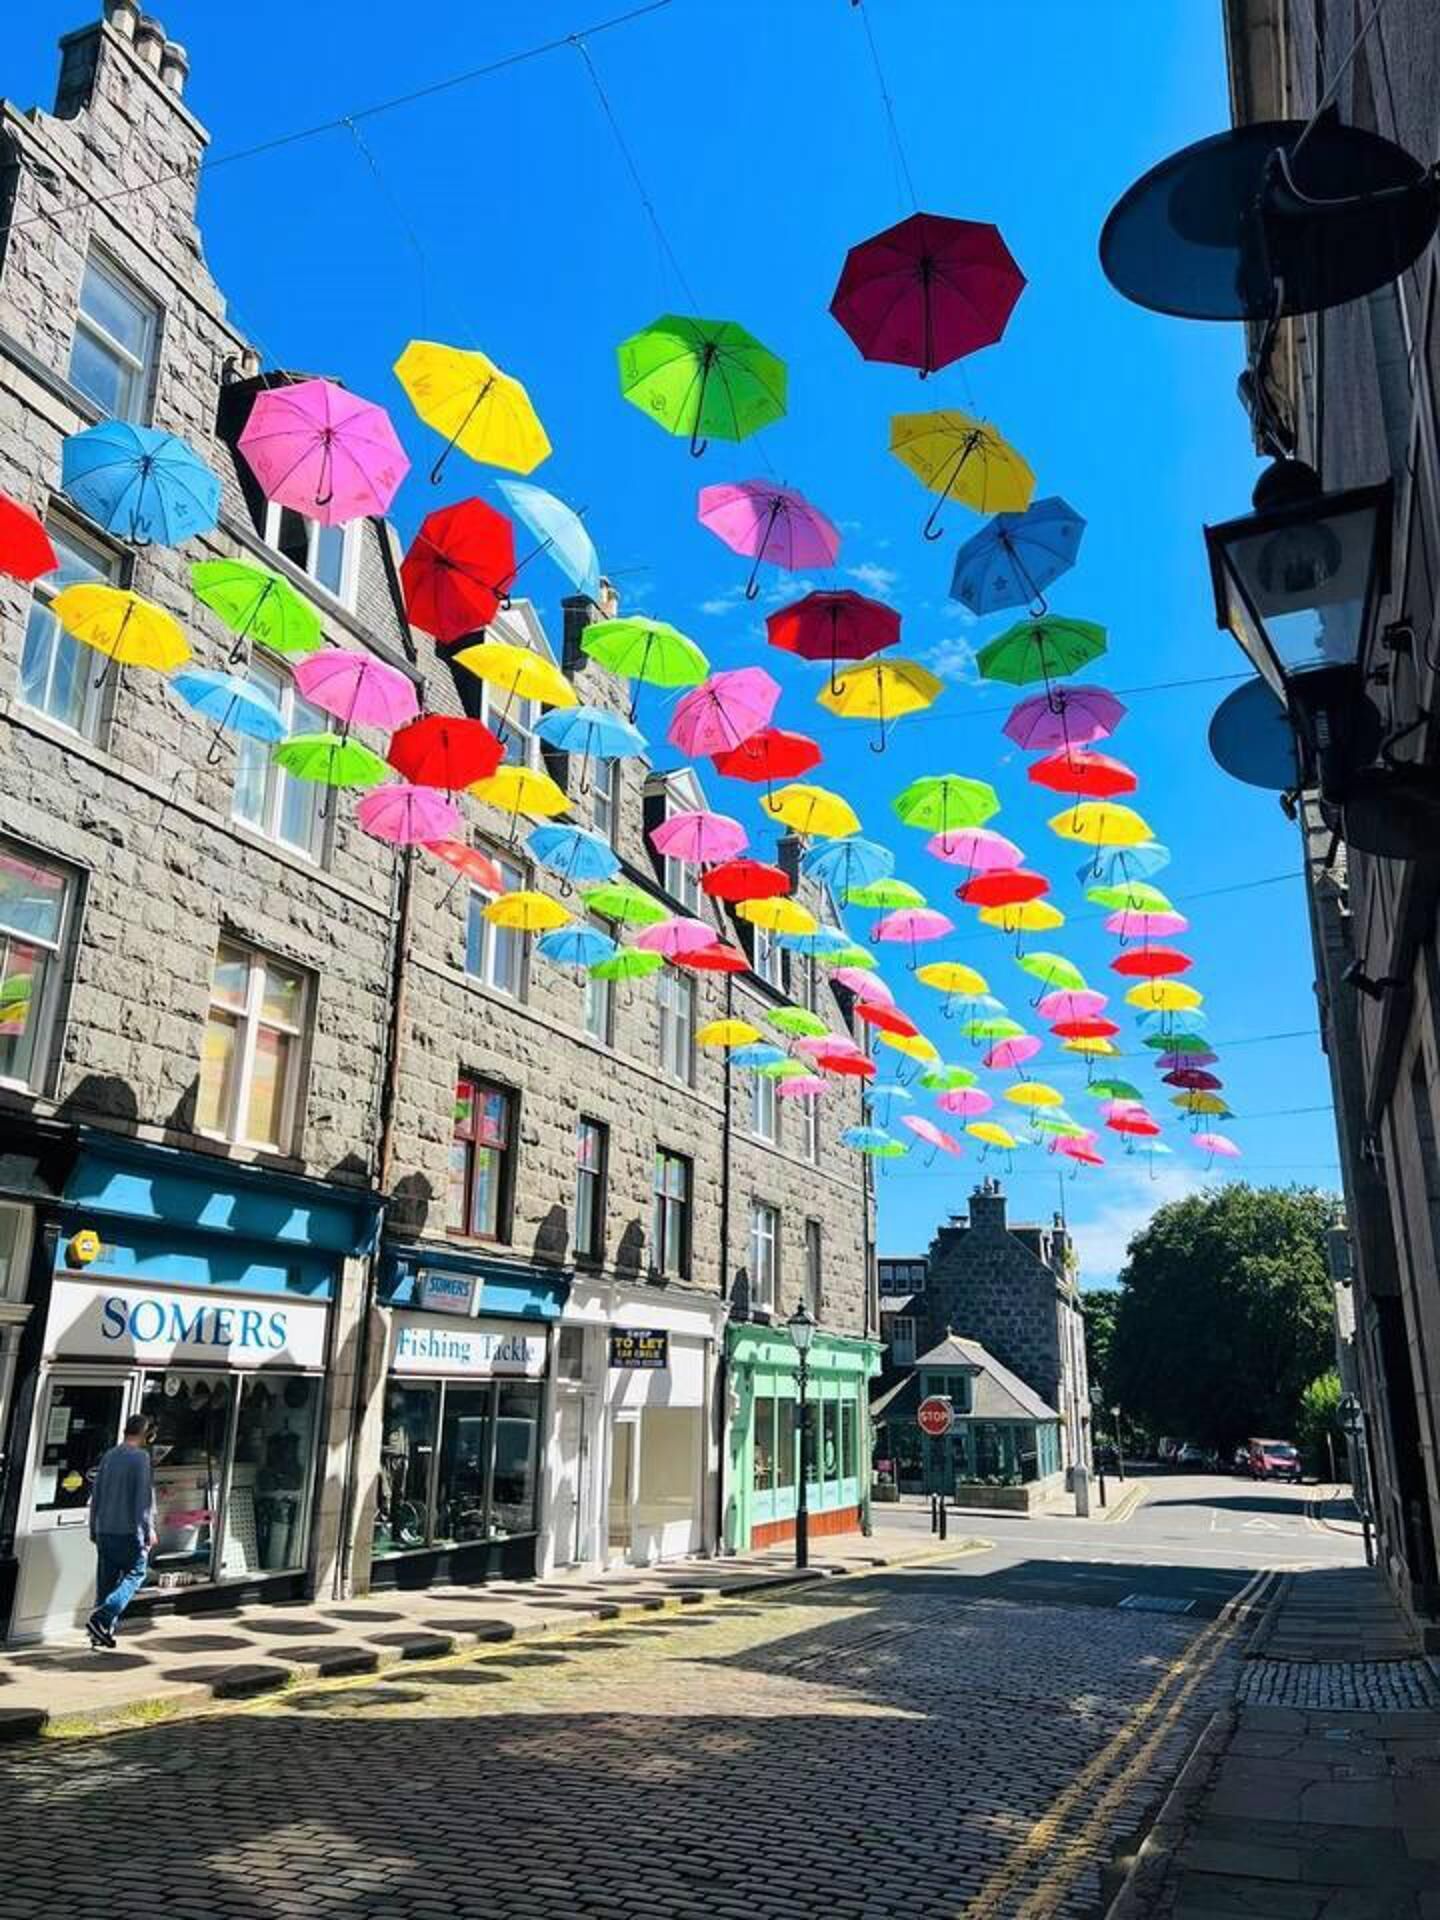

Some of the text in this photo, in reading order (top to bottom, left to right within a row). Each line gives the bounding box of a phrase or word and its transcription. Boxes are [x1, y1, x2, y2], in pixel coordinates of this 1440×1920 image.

[101, 1297, 287, 1348] SOMERS
[399, 1327, 535, 1362] Fishing Tackle
[614, 1337, 665, 1349] TO LET
[920, 1410, 949, 1422] STOP
